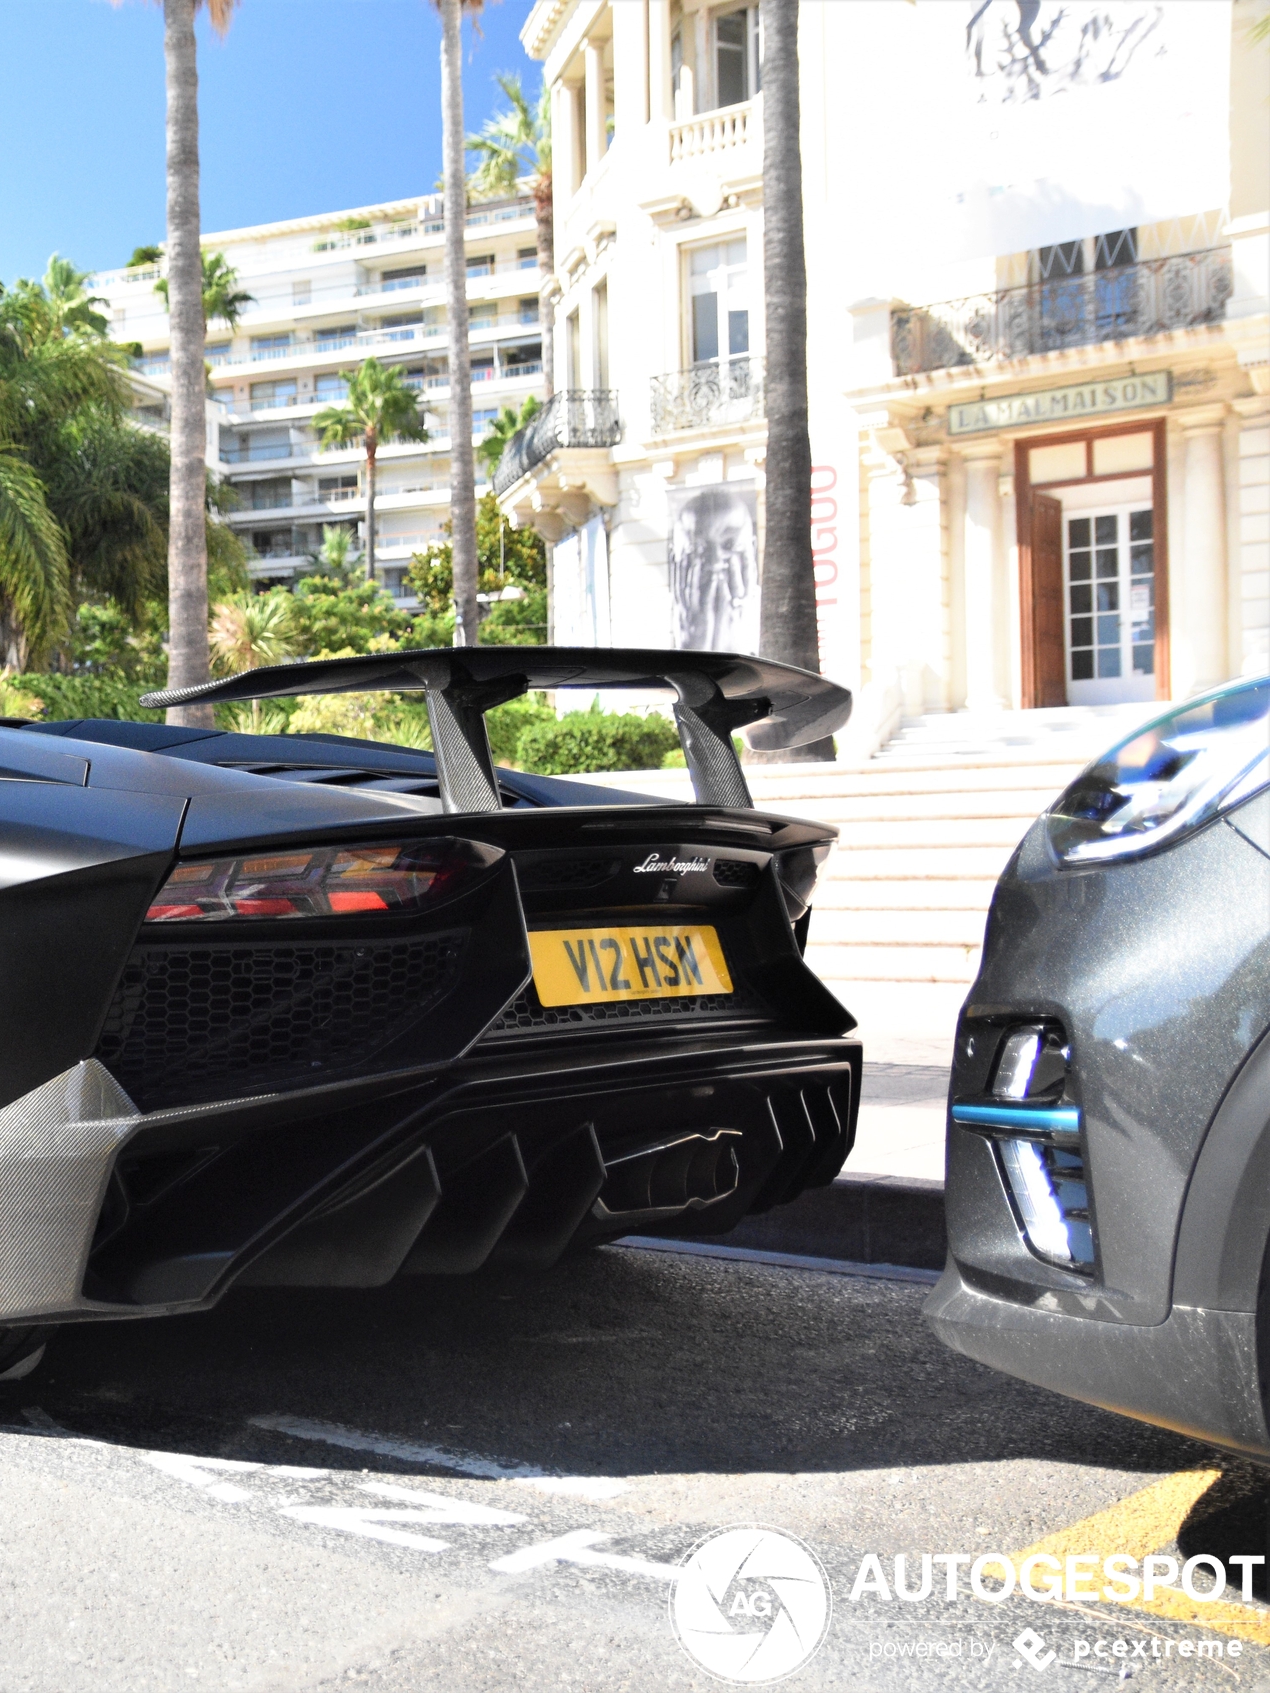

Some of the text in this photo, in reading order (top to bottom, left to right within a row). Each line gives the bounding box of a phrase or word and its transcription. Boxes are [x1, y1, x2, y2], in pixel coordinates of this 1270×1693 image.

[633, 853, 710, 876] Lamborghini
[562, 935, 704, 993] V12 HSN
